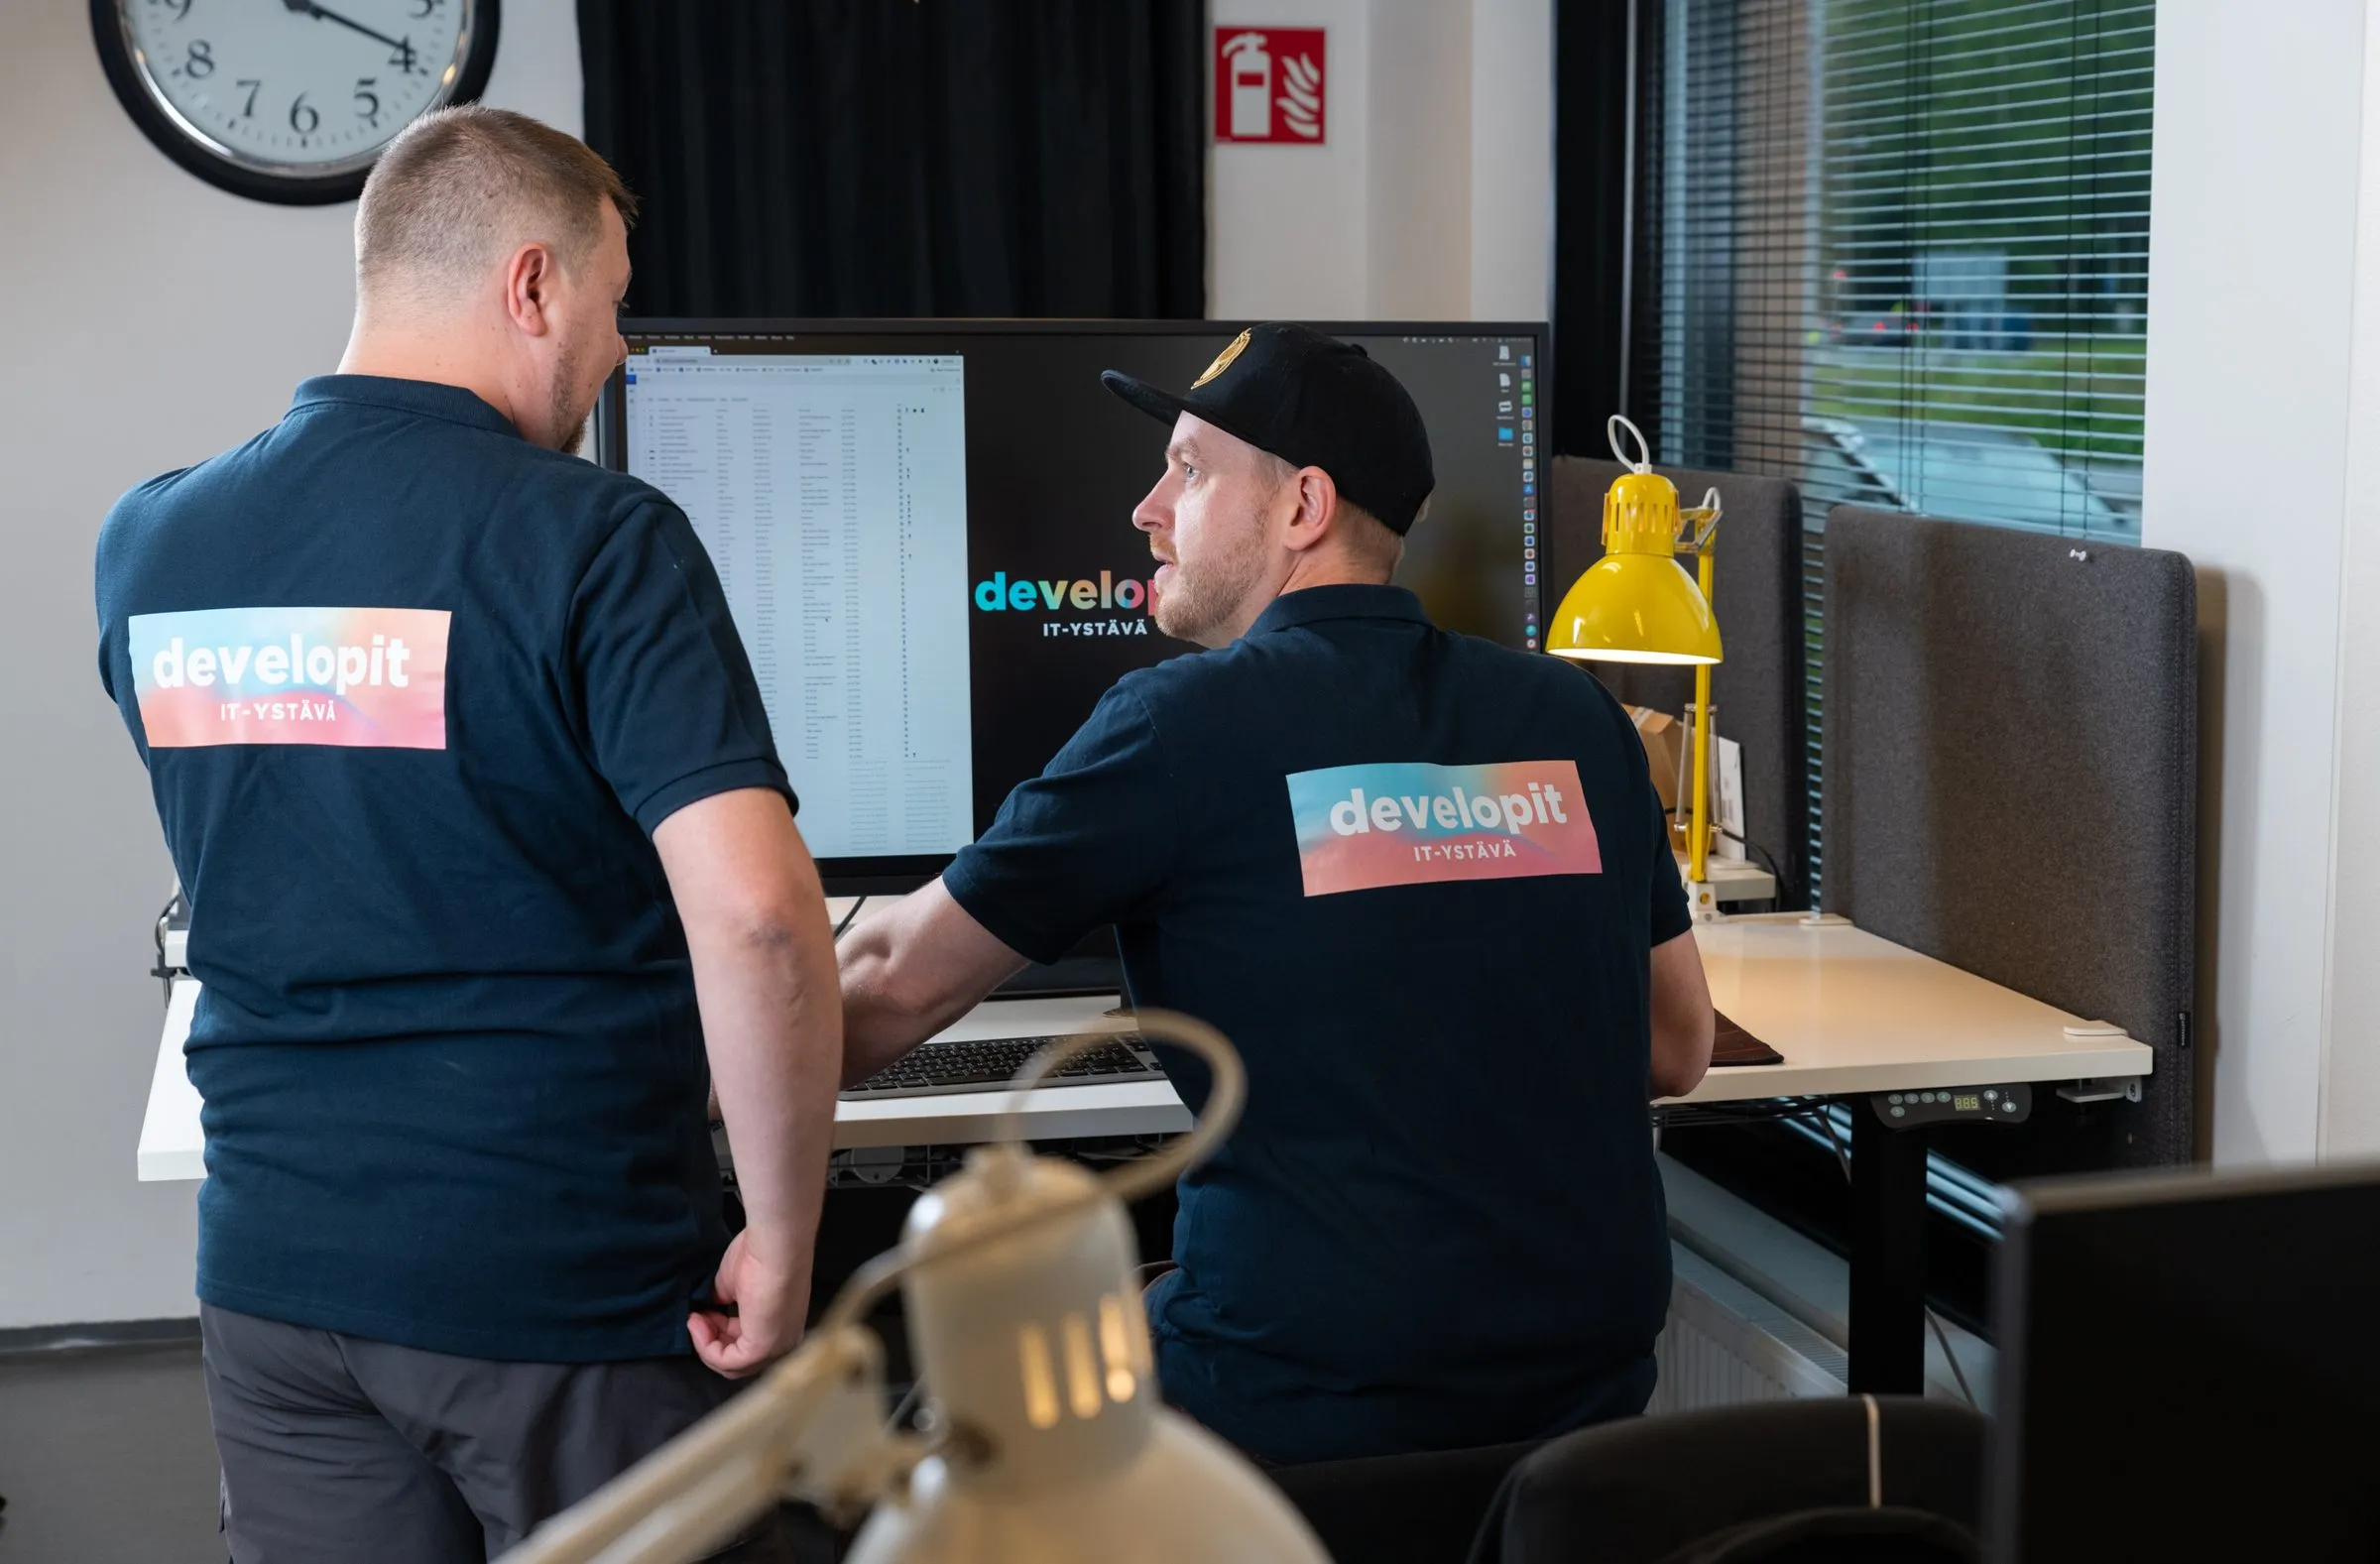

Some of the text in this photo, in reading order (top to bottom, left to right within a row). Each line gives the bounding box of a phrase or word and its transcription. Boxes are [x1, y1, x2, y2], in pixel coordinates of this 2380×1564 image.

[185, 39, 215, 78] 8
[387, 34, 416, 74] 4
[236, 79, 261, 118] 7
[290, 89, 319, 134] 6
[354, 77, 379, 119] 5
[1043, 619, 1147, 637] IT-YSTÄVÄ
[153, 633, 411, 695] developit
[220, 699, 335, 721] IT-YSTÄVÄ
[1330, 782, 1568, 835] developit
[1414, 839, 1517, 861] IT-YSTÄVÄ
